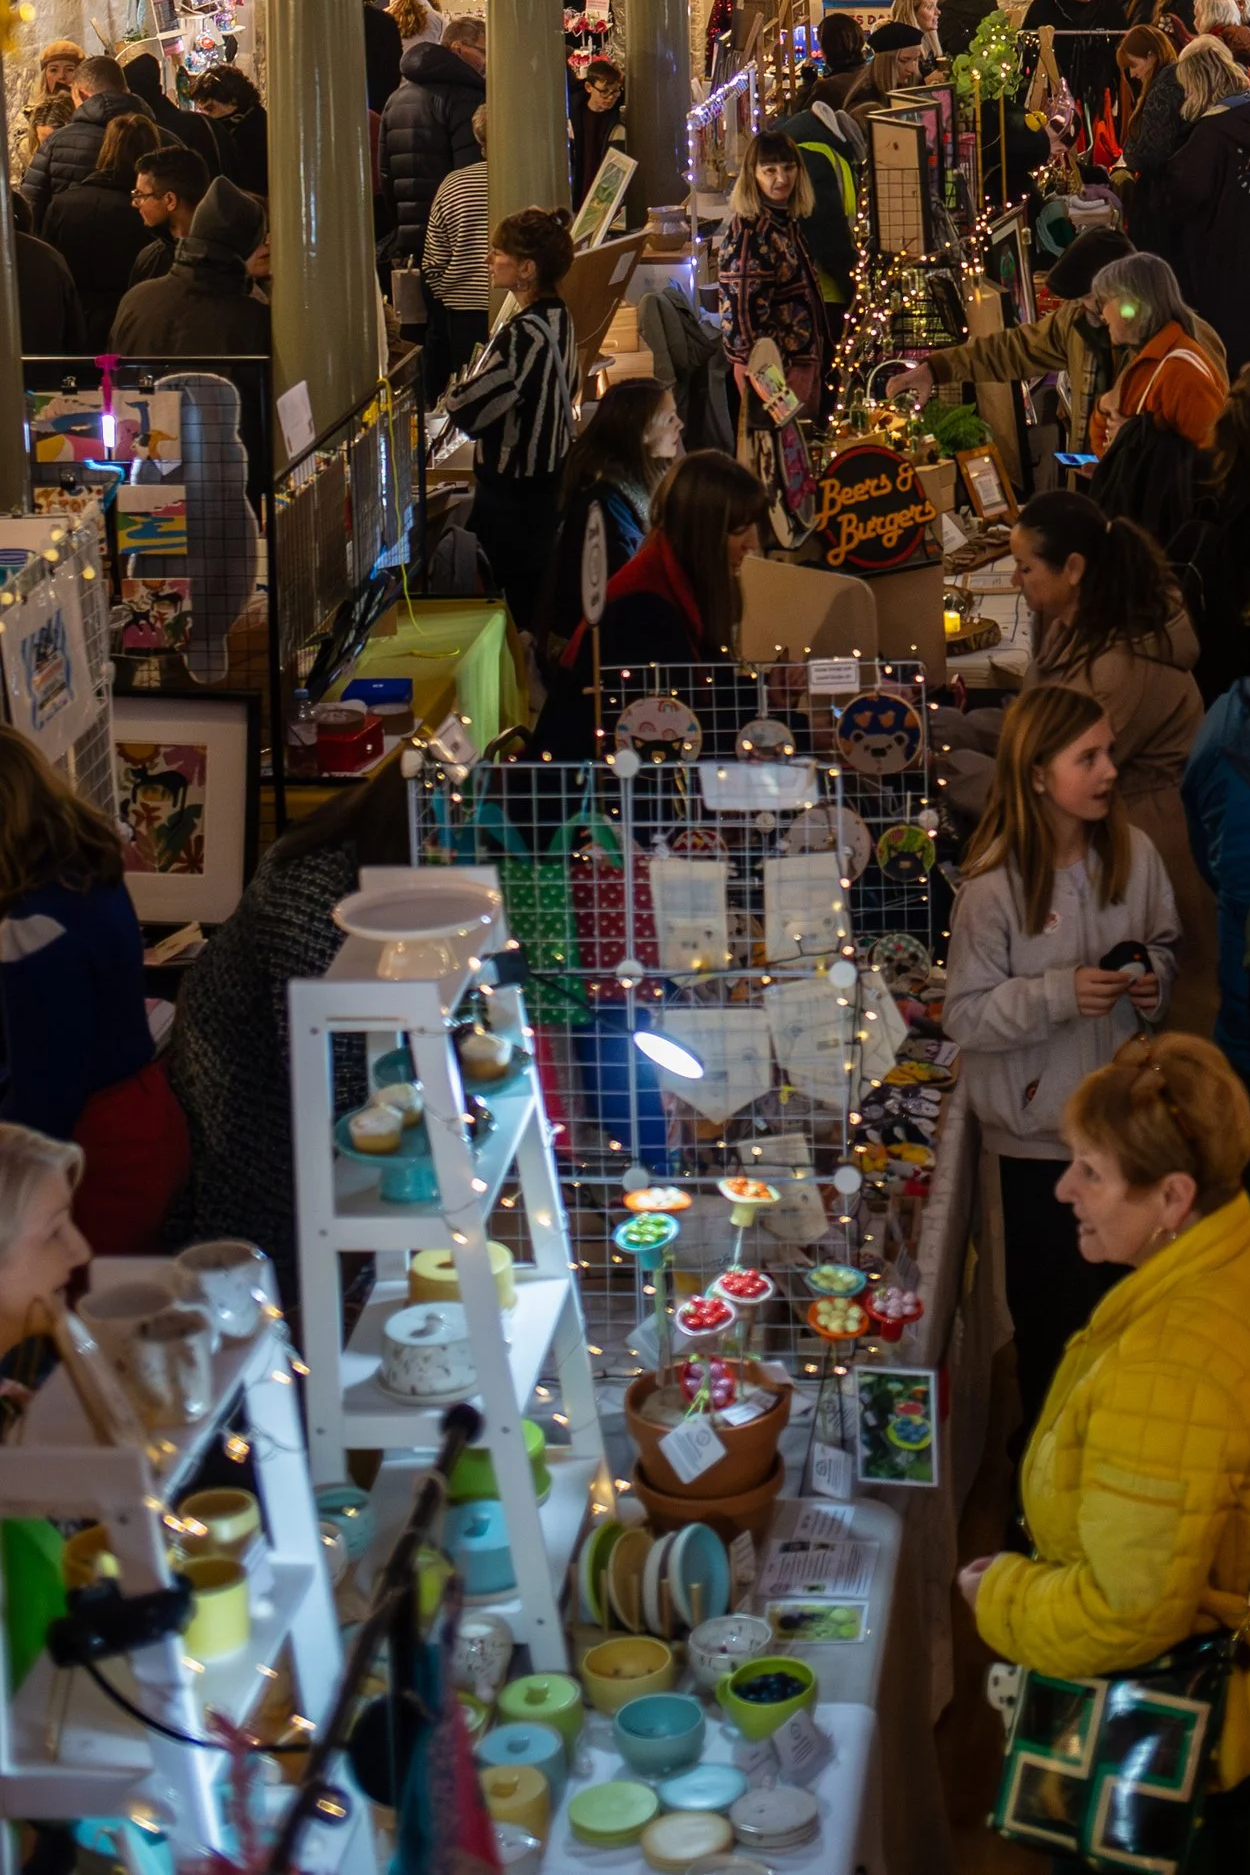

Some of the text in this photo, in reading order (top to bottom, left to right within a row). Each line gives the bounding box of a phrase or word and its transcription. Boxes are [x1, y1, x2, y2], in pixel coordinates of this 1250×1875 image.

[814, 462, 914, 531] Beers &
[827, 498, 938, 566] Burgers
